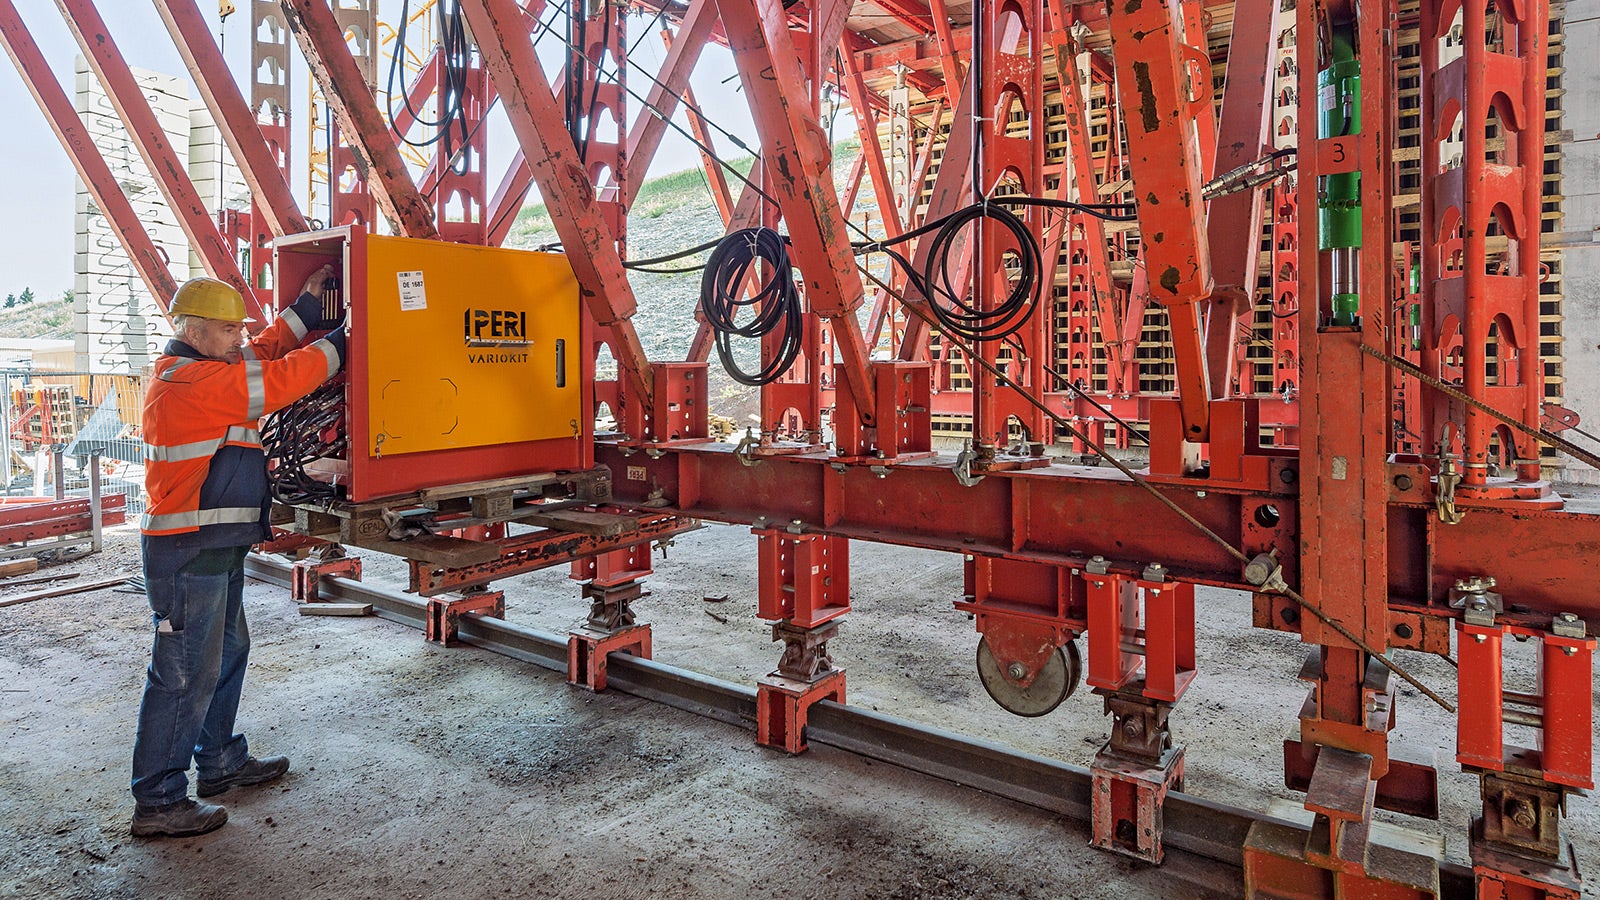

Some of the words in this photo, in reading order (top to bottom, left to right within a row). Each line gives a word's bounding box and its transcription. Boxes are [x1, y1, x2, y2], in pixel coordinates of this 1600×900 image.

[1333, 143, 1345, 162] 3
[474, 310, 526, 337] PERI
[468, 353, 529, 363] VARIOKIT
